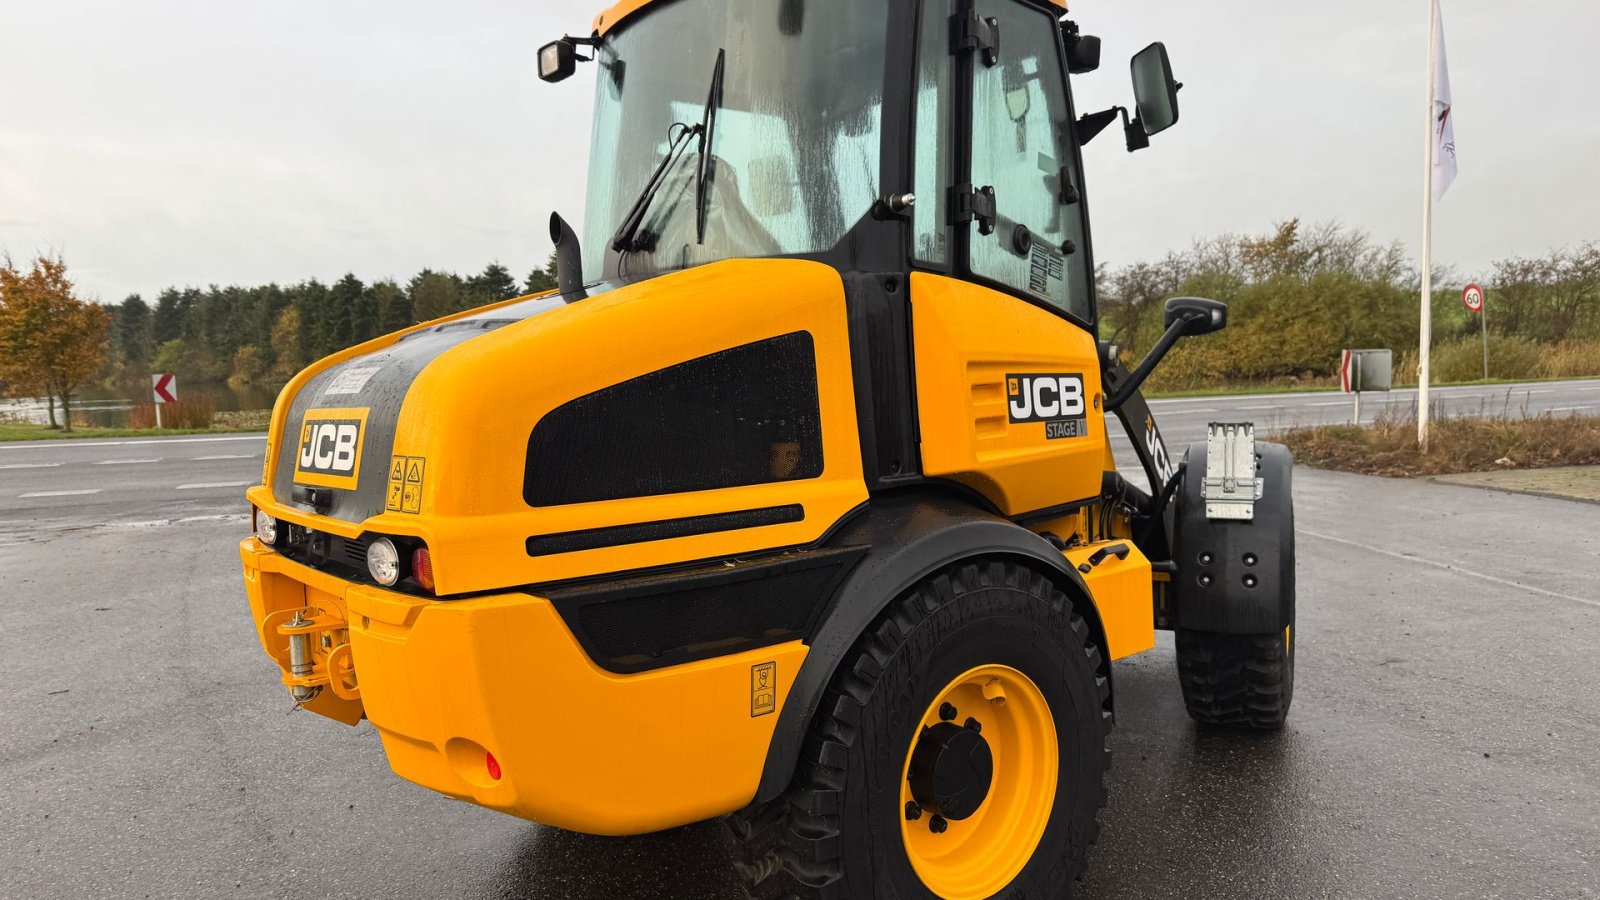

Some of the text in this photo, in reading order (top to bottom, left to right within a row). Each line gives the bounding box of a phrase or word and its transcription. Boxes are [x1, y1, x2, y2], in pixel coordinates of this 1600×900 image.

[1467, 293, 1479, 304] 60
[1010, 377, 1084, 419] JCB
[1047, 421, 1075, 438] STAGE
[300, 424, 358, 471] JCB
